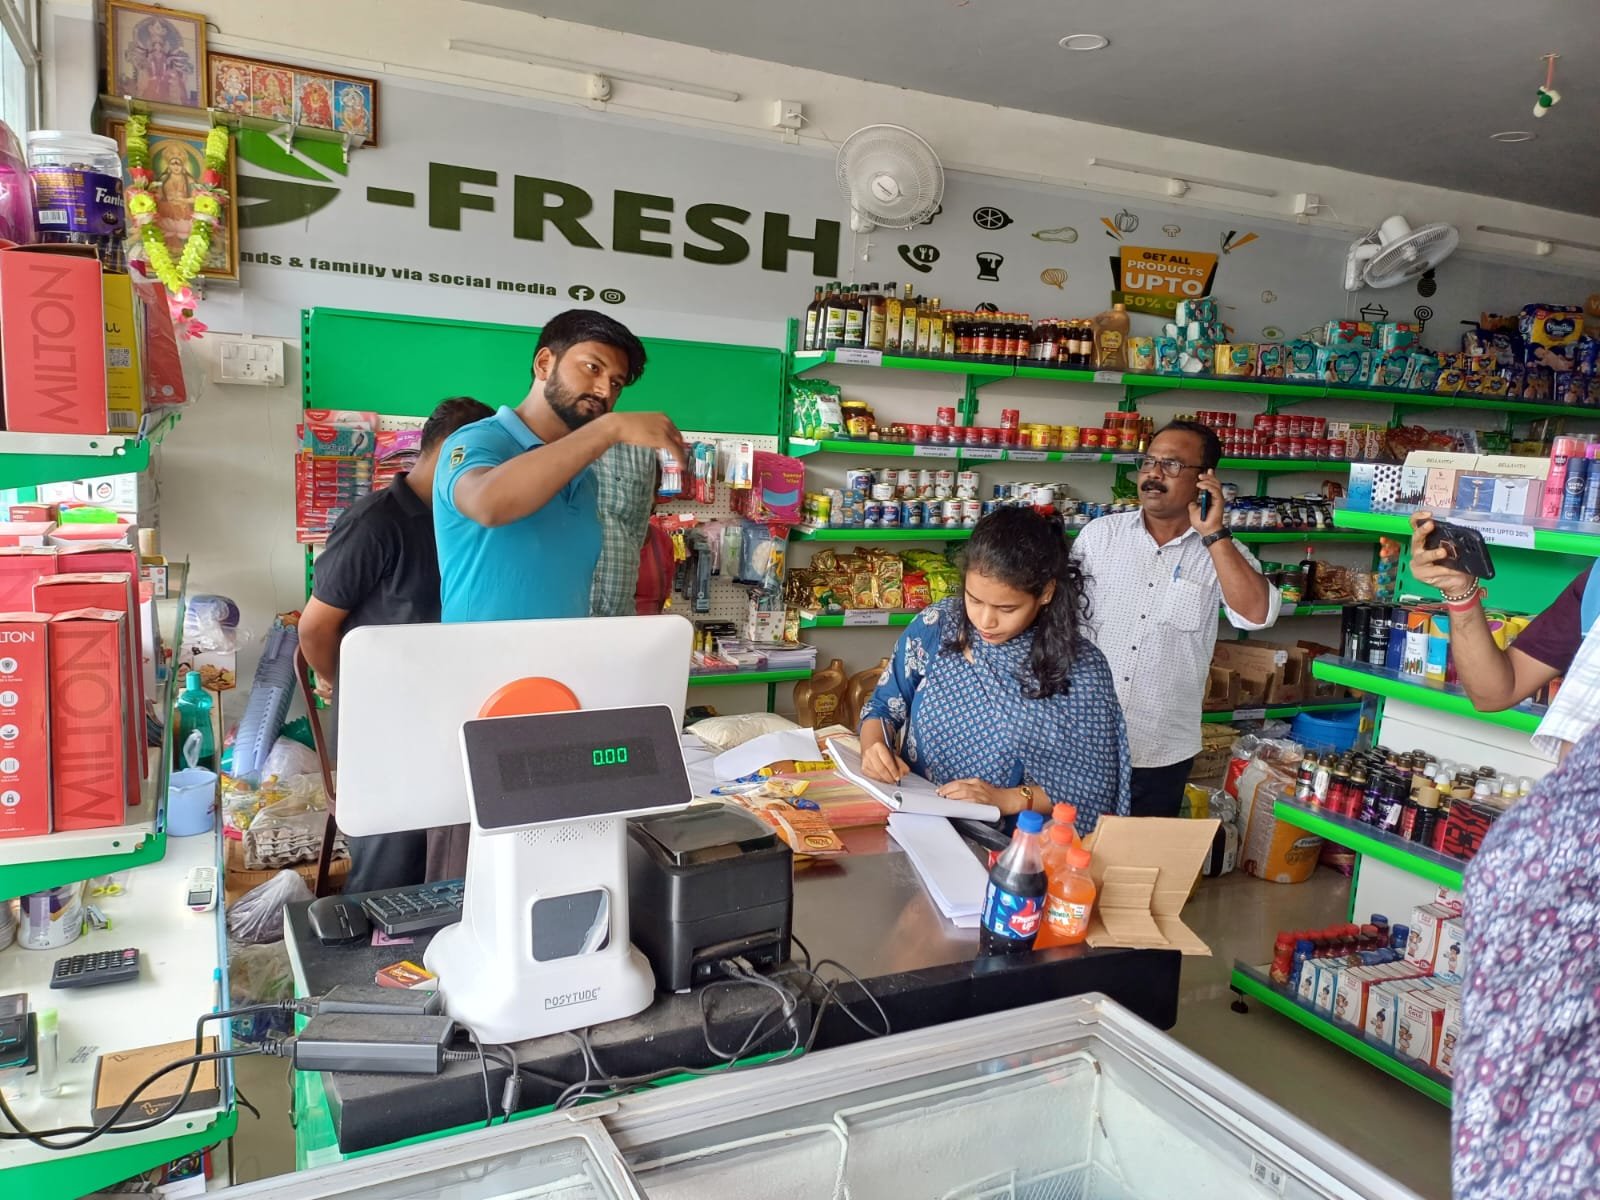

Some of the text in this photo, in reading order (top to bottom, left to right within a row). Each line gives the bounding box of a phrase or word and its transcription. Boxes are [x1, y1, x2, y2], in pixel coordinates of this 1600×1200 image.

[1127, 260, 1204, 277] PRODUCTS
[1142, 251, 1191, 265] GET ALL
[289, 256, 303, 268] &
[392, 268, 422, 282] via
[428, 272, 491, 289] social
[497, 280, 557, 296] media
[1125, 272, 1204, 296] UPTO
[1124, 295, 1161, 309] 50%
[29, 263, 79, 425] MILTON
[55, 630, 116, 821] MILTON
